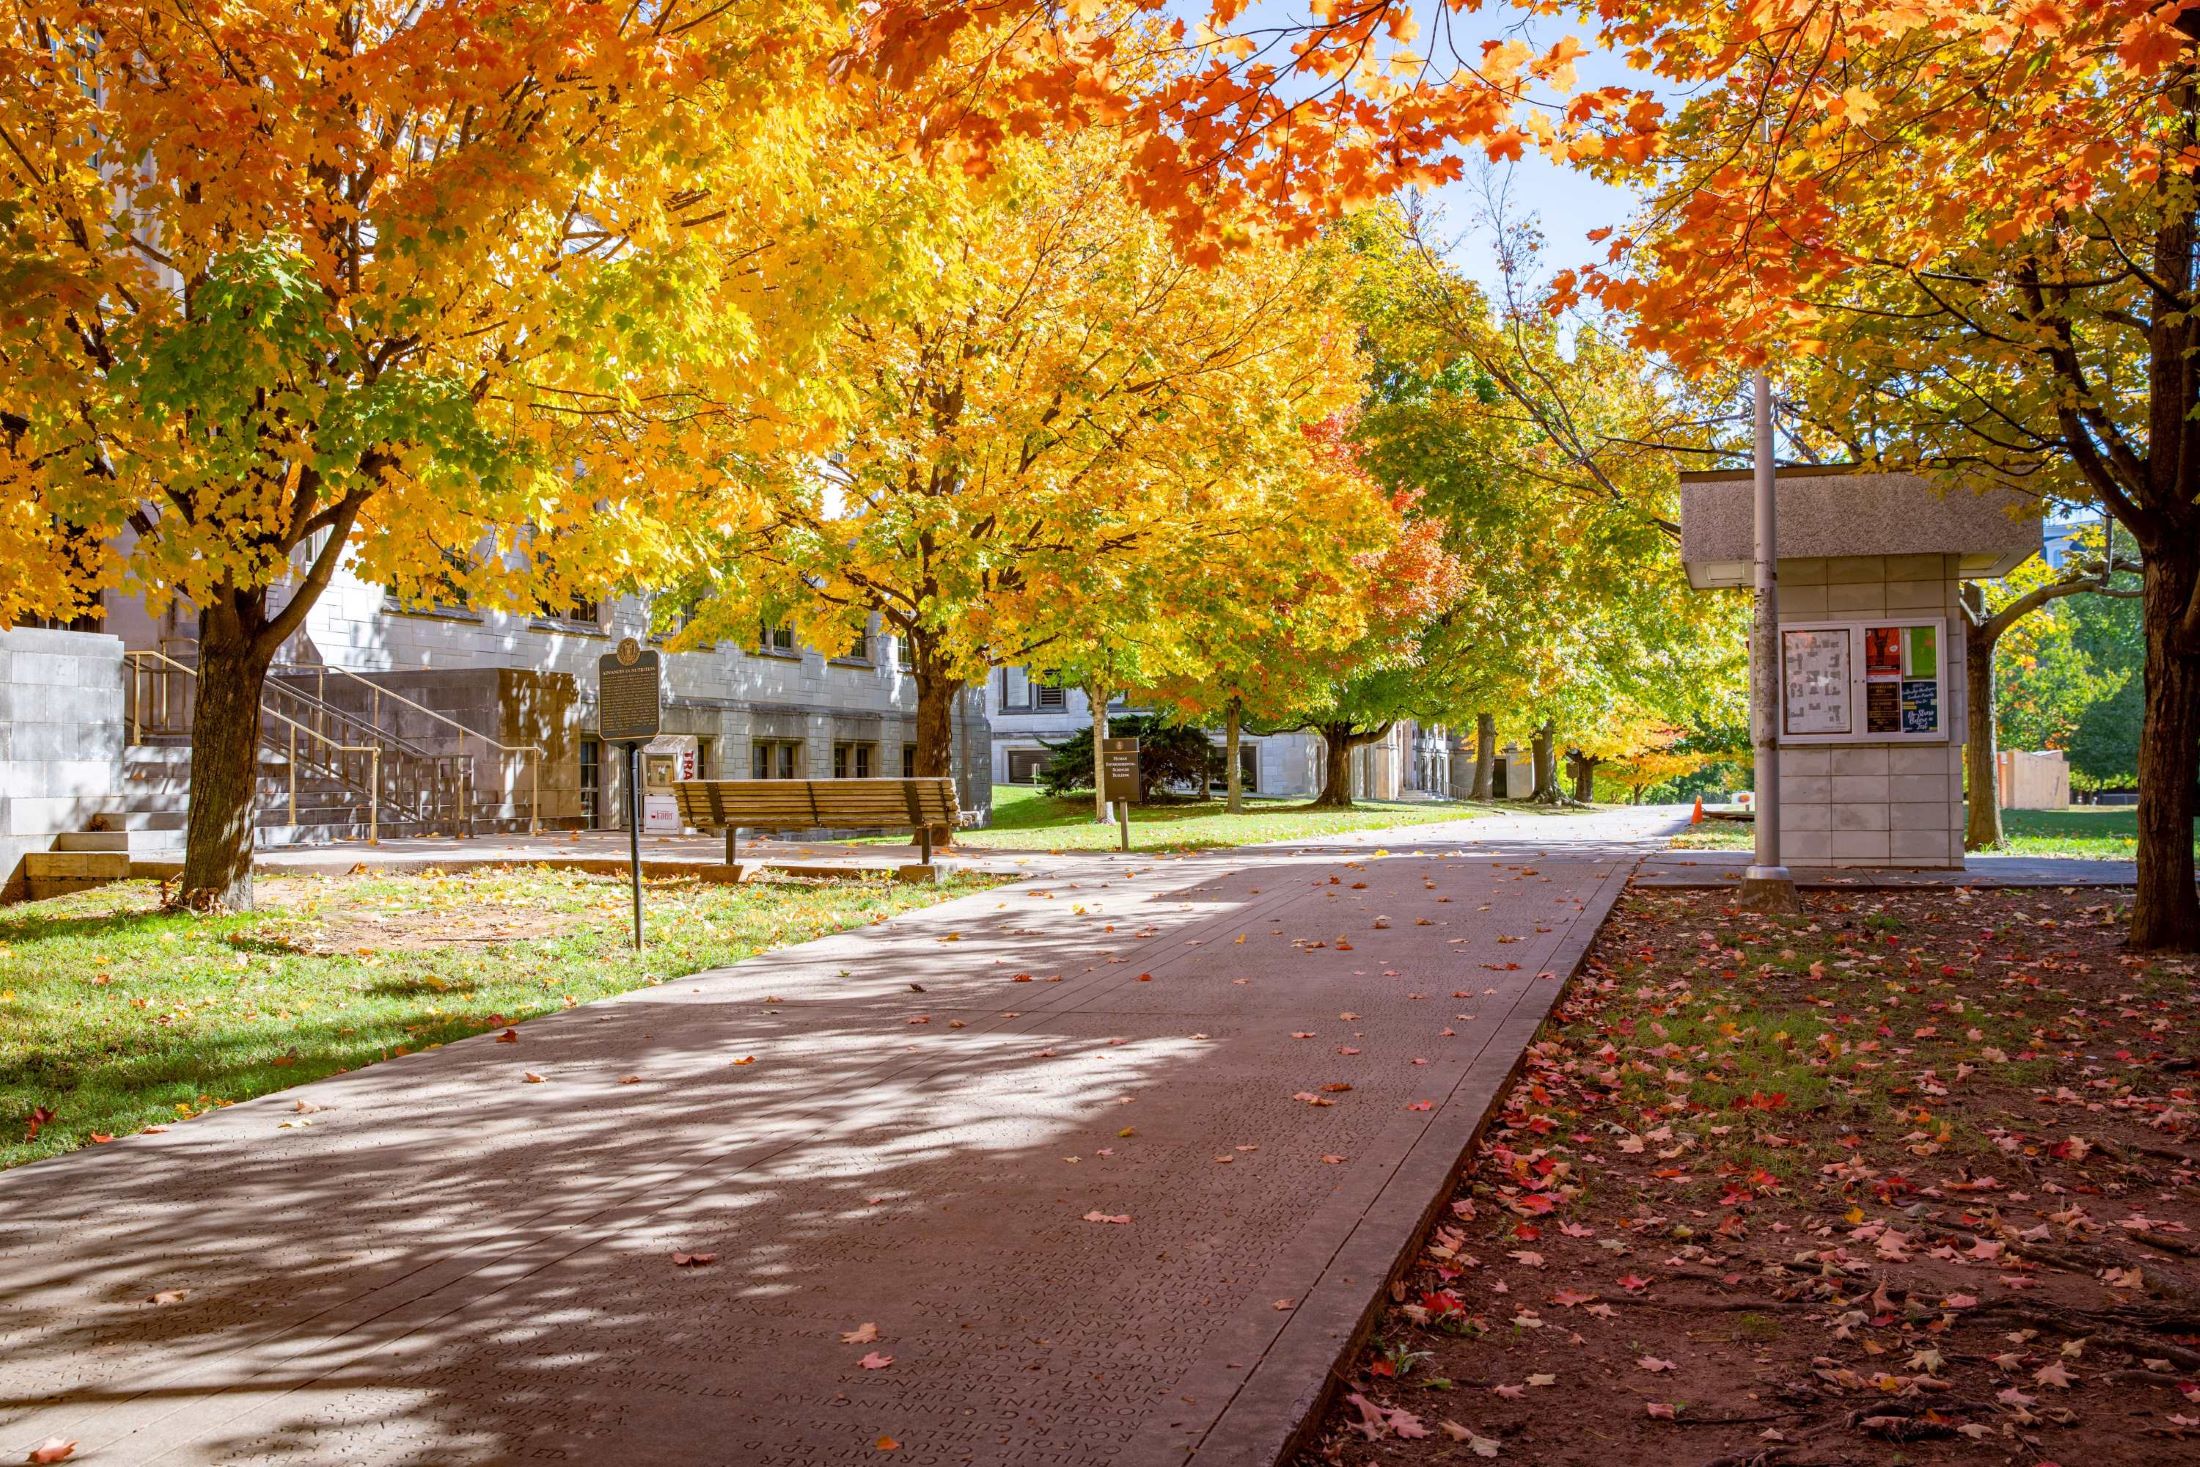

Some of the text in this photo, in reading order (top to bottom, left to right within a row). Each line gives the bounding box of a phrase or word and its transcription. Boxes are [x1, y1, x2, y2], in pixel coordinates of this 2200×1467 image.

[1222, 1238, 1291, 1246] JOHN
[1113, 1287, 1248, 1300] MARJORIE
[912, 1310, 987, 1320] DAKE
[1030, 1307, 1145, 1320] HOWARD
[1146, 1306, 1234, 1317] JAMES
[1157, 1315, 1228, 1326] DEAN
[1162, 1325, 1220, 1335] JOY
[1158, 1335, 1212, 1344] TED
[1134, 1343, 1205, 1354] JUDY
[918, 1349, 1188, 1374] REBECCA DAGGETT
[1066, 1349, 1198, 1364] MAURICE
[909, 1358, 1000, 1371] DACUS
[608, 1368, 693, 1381] SMITH
[881, 1366, 1013, 1383] CUSHING
[1042, 1367, 1180, 1384] PATRICIA
[488, 1370, 602, 1386] HOWARD
[602, 1380, 697, 1394] SMITH,
[488, 1382, 572, 1396] SMITH
[831, 1374, 1164, 1406] NANCEY CURTSINGER
[768, 1392, 980, 1417] CUNNINGHAM
[889, 1389, 1154, 1418] JOSEPHINE CURE
[481, 1406, 578, 1421] SMITH,
[802, 1420, 884, 1433] CULP,
[935, 1418, 1016, 1432] CULP
[1038, 1414, 1144, 1429] ROGER
[894, 1427, 977, 1442] HELM
[1067, 1429, 1133, 1442] ROY
[819, 1447, 941, 1465] CRUMP,
[848, 1436, 1113, 1467] PHILLIP CRUVR
